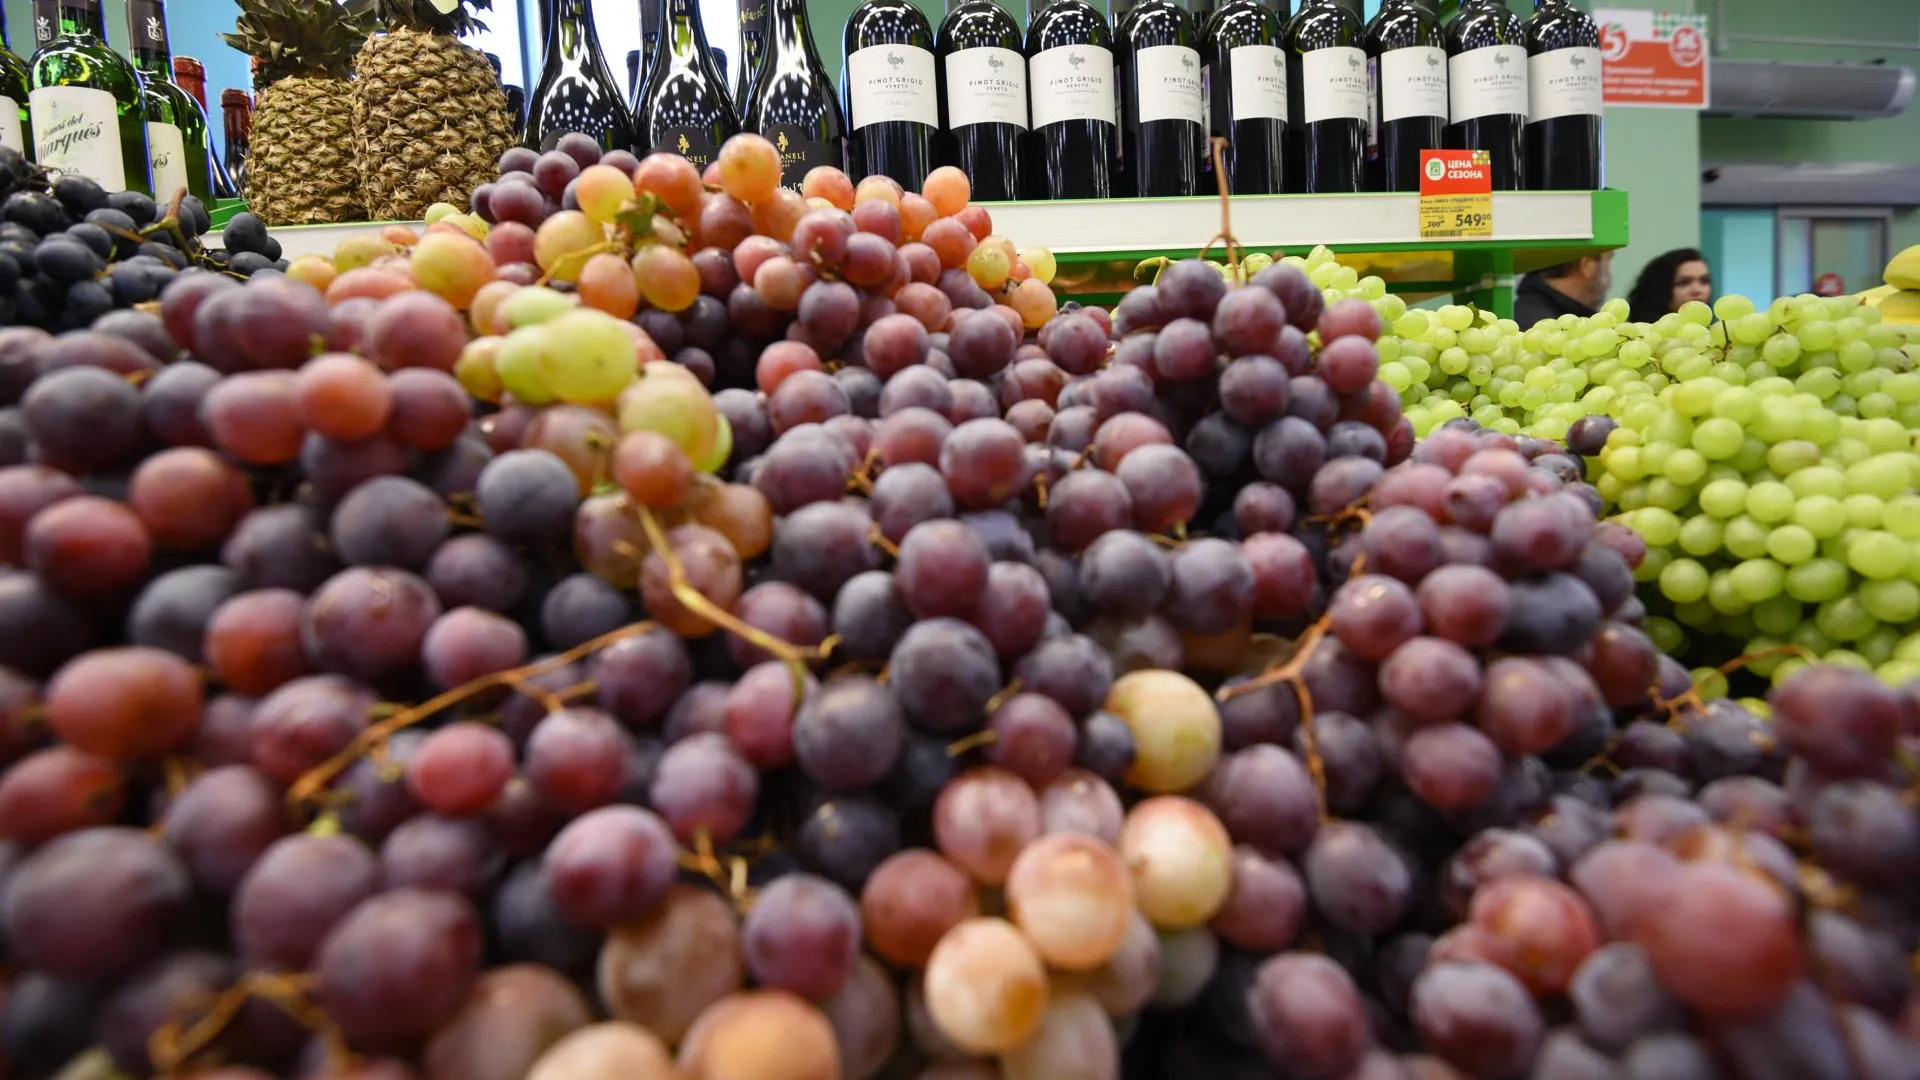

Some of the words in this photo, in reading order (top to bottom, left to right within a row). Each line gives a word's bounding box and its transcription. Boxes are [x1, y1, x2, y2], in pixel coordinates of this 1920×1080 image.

[869, 76, 893, 86] PINOT
[896, 76, 923, 86] GRIGIO
[969, 79, 994, 87] PINOT
[1050, 76, 1074, 86] PINOT
[1076, 76, 1103, 84] GRIGIO
[67, 113, 84, 127] del
[1447, 160, 1472, 169] ЦЕНА
[1447, 170, 1483, 179] СЕЗОНА
